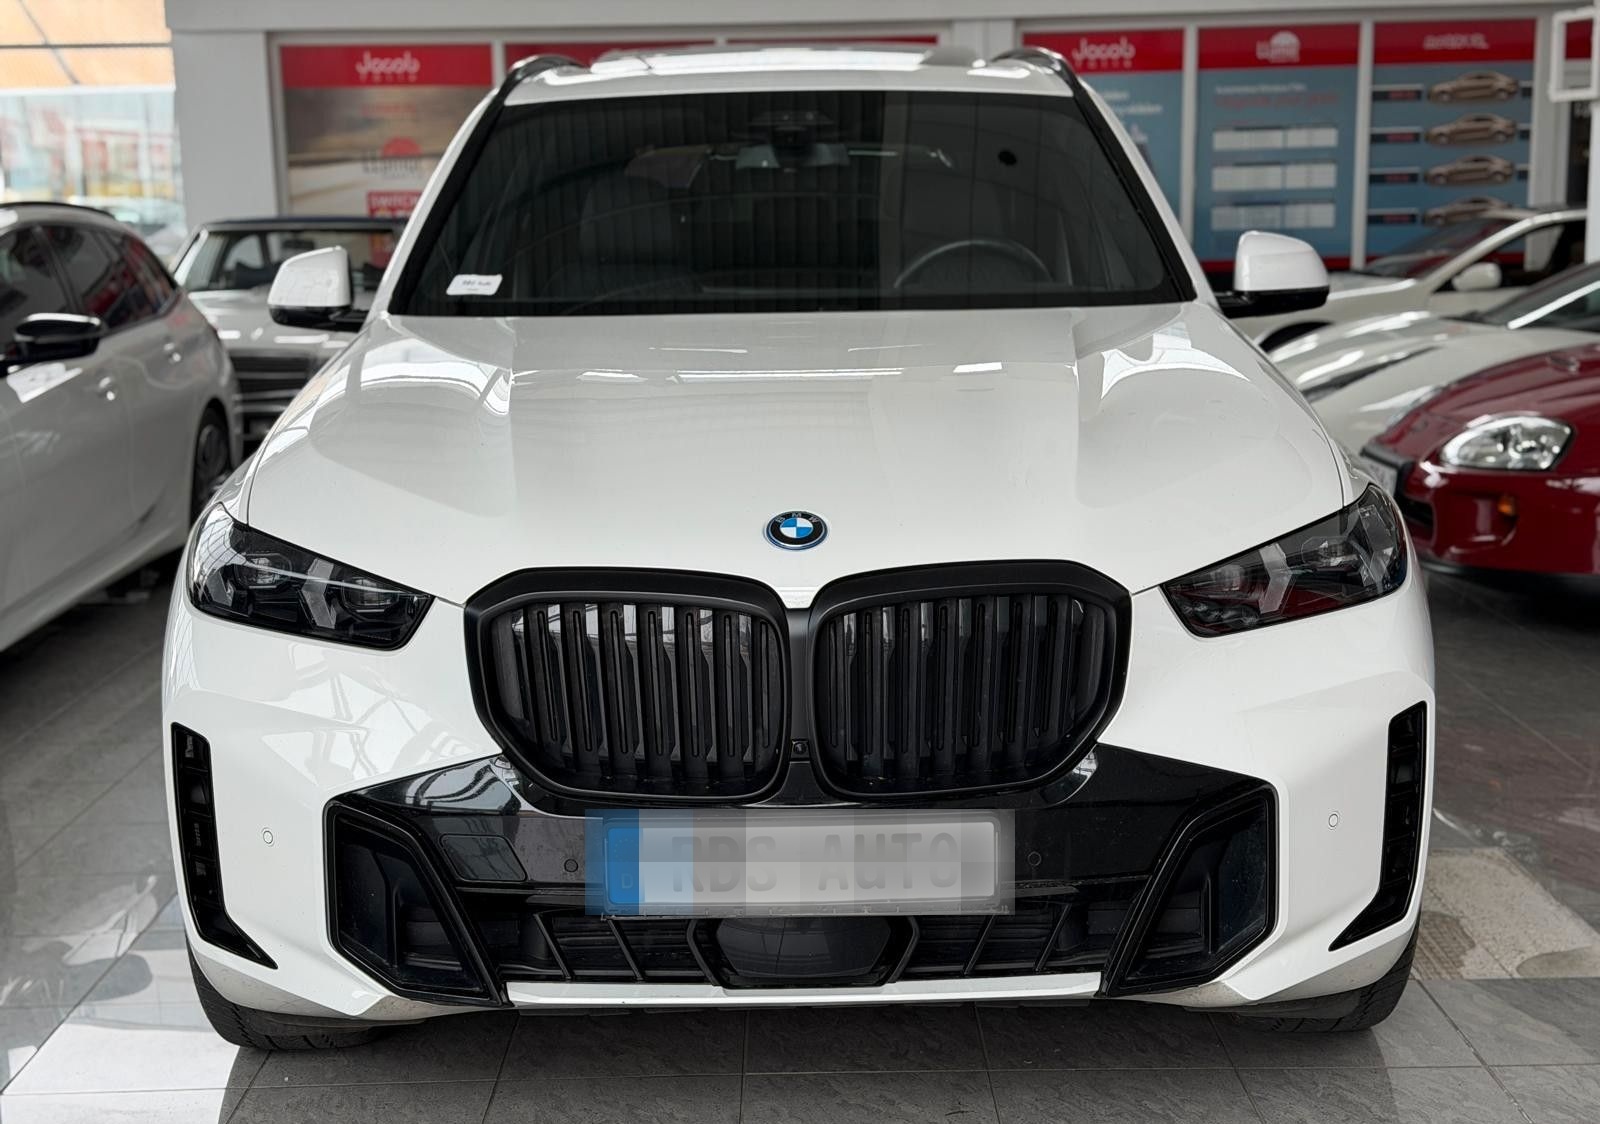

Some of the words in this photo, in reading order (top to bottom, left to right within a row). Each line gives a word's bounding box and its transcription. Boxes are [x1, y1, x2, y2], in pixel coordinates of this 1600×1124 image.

[621, 873, 634, 889] D
[672, 835, 777, 893] RDS
[818, 832, 959, 891] AUTO
